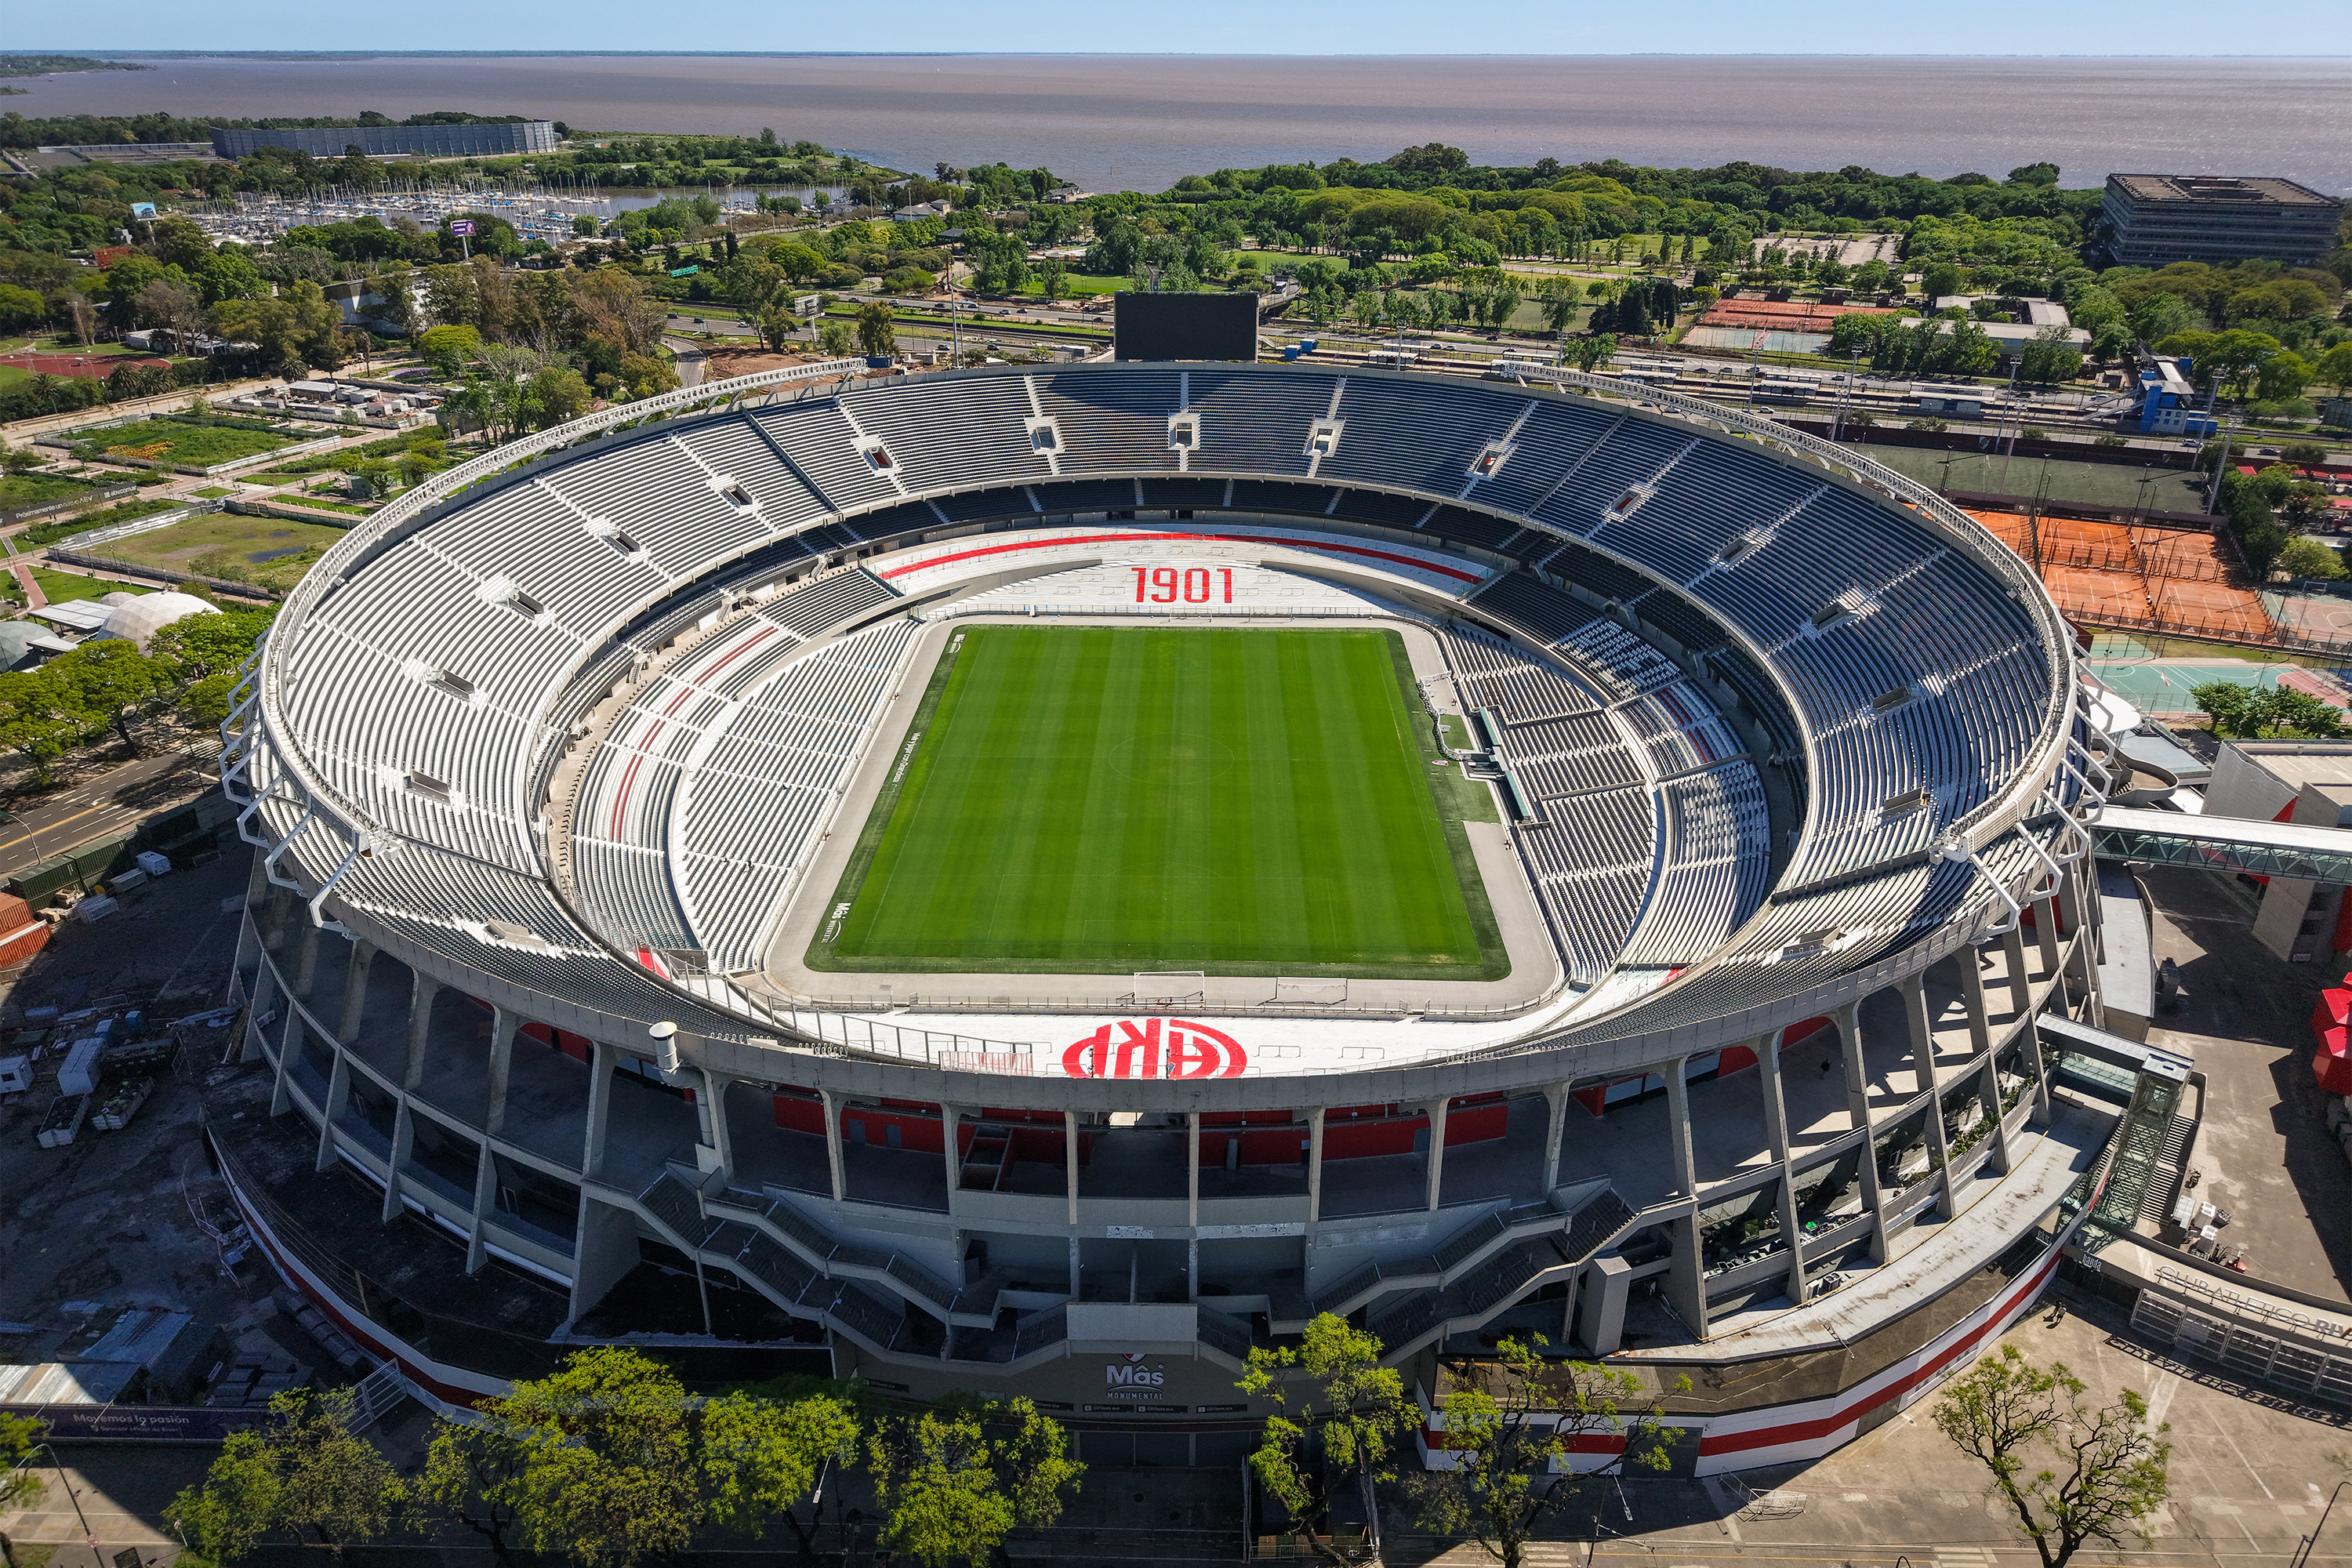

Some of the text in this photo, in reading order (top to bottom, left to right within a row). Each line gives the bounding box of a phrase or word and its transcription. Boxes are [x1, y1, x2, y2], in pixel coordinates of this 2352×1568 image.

[1131, 568, 1232, 604] 1901
[2160, 1265, 2209, 1293] CLUB
[2212, 1287, 2310, 1327] ATLETICO
[73, 1414, 190, 1425] Movemos la pasión
